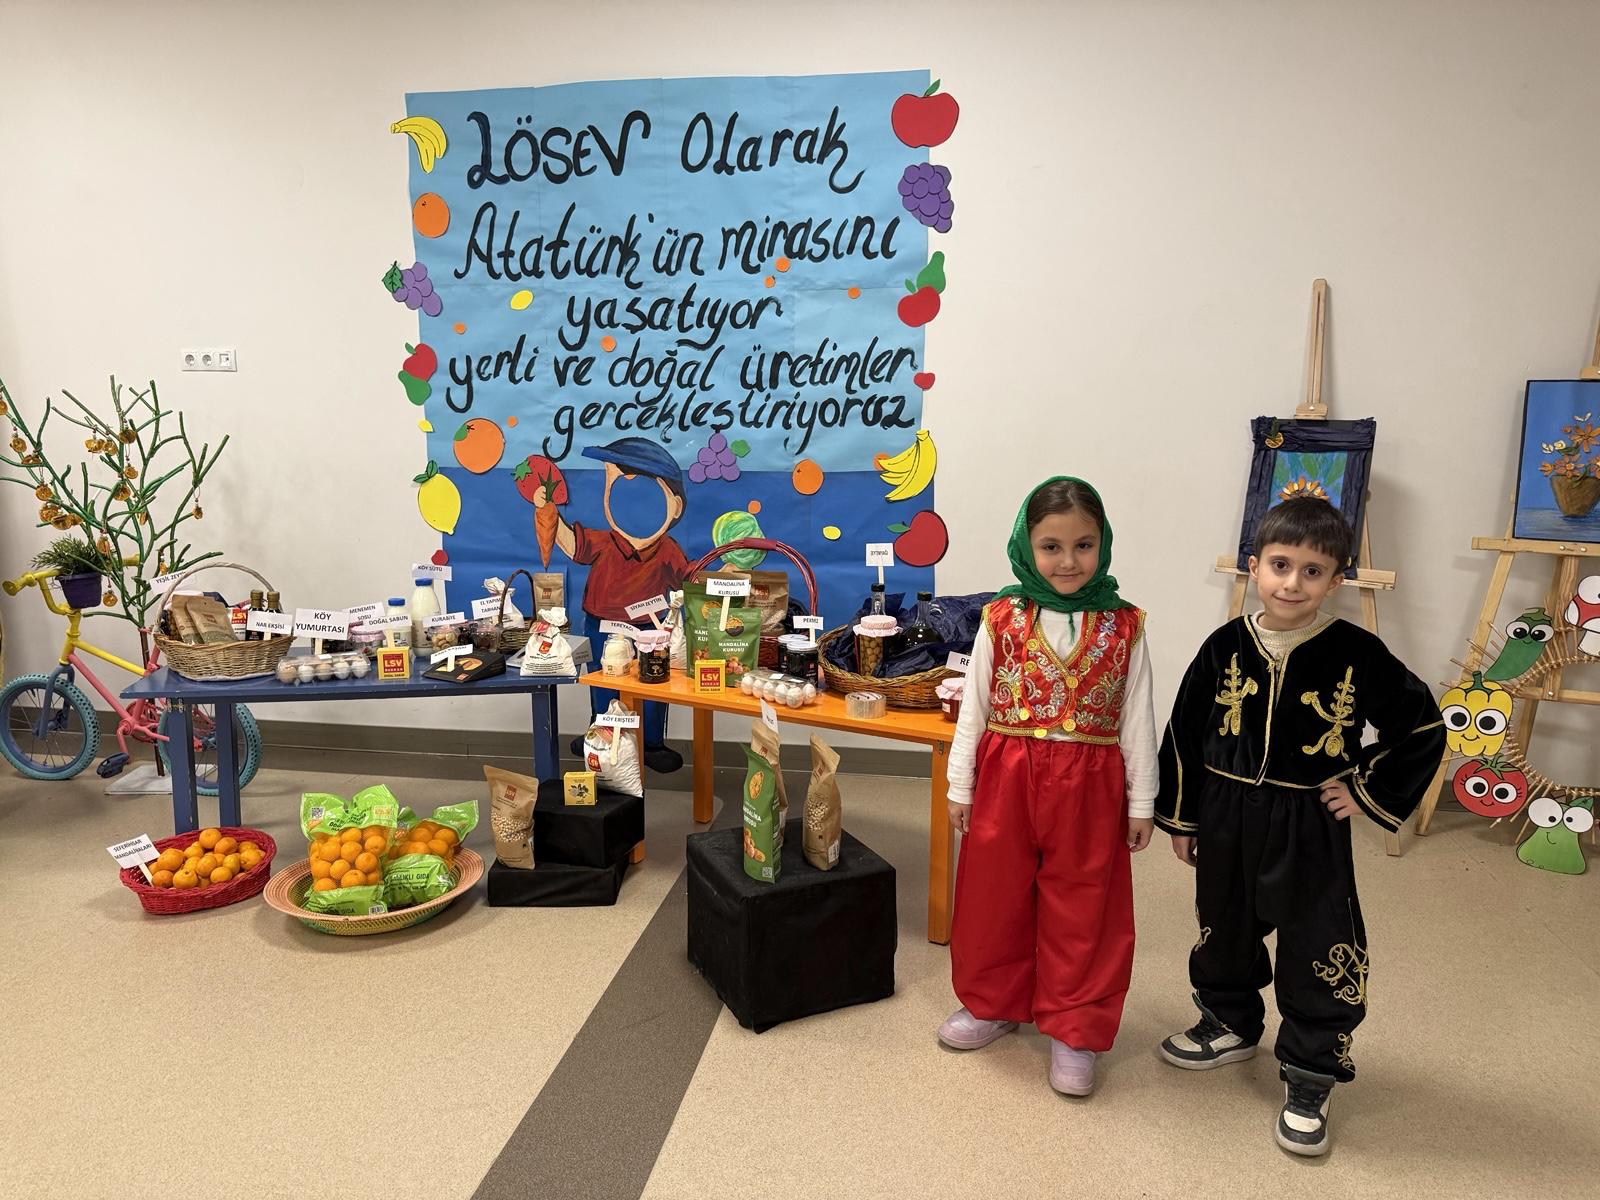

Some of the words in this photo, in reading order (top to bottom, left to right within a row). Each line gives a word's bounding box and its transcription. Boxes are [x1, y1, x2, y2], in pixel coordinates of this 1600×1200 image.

[466, 109, 652, 190] LÖSEV
[453, 201, 705, 290] Atatürk'ün
[717, 215, 901, 275] mirasını
[445, 334, 540, 414] yerli
[553, 354, 596, 388] ve
[607, 337, 726, 408] doğal
[739, 336, 918, 395] üretimler
[349, 605, 376, 614] MENEMEN
[481, 606, 501, 614] TARHAN
[314, 611, 332, 621] KÖY
[368, 617, 389, 626] DOĞAL
[389, 615, 409, 623] SABUN
[431, 614, 456, 623] KURABİYE
[295, 622, 345, 634] YUMURTASI
[384, 659, 403, 668] LSV
[701, 673, 720, 681] LSV
